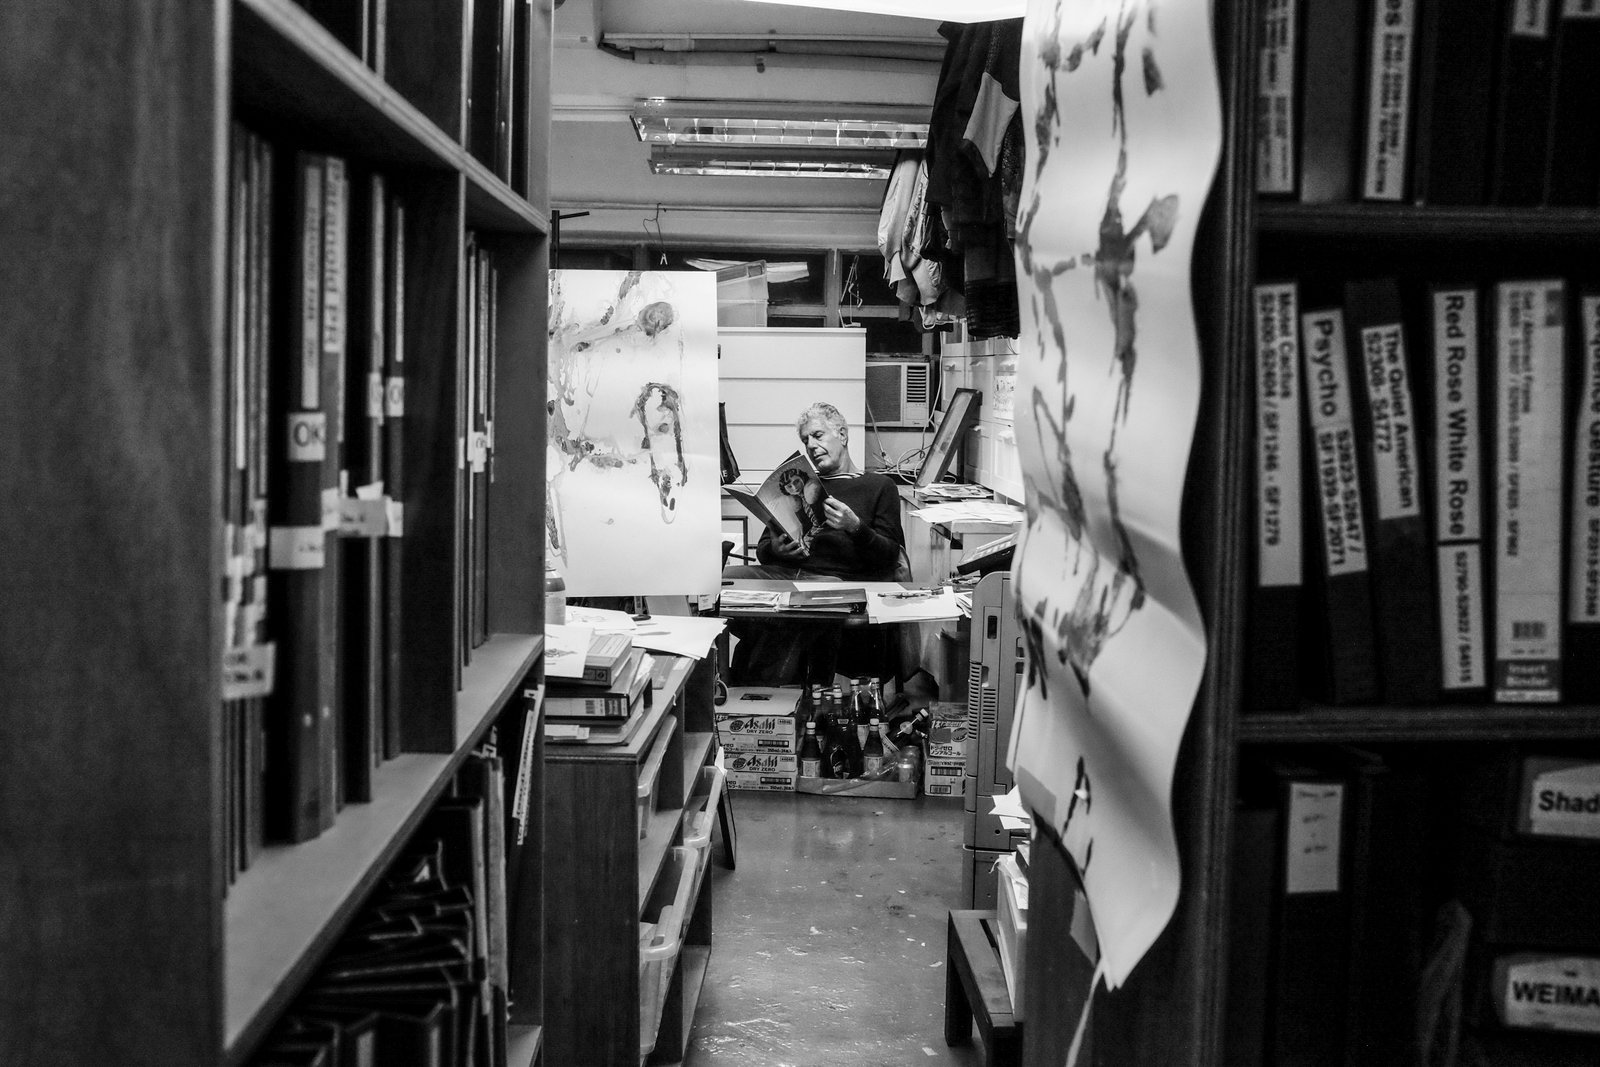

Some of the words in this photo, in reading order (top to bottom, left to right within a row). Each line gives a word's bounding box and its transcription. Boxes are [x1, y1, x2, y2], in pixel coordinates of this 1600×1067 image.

[1446, 295, 1466, 339] Red
[1280, 341, 1294, 399] Cactus
[1311, 319, 1338, 418] Psycho
[1386, 330, 1400, 365] The
[1447, 345, 1466, 403] Rose
[1389, 368, 1407, 418] Quiet
[1395, 422, 1414, 509] American
[1448, 408, 1468, 472] White
[1587, 420, 1600, 508] Gesture
[1449, 479, 1469, 535] Rose
[744, 717, 775, 730] Asahi
[746, 755, 778, 767] Asahi
[1538, 790, 1600, 814] Shad
[1512, 980, 1600, 1007] WEIMA
